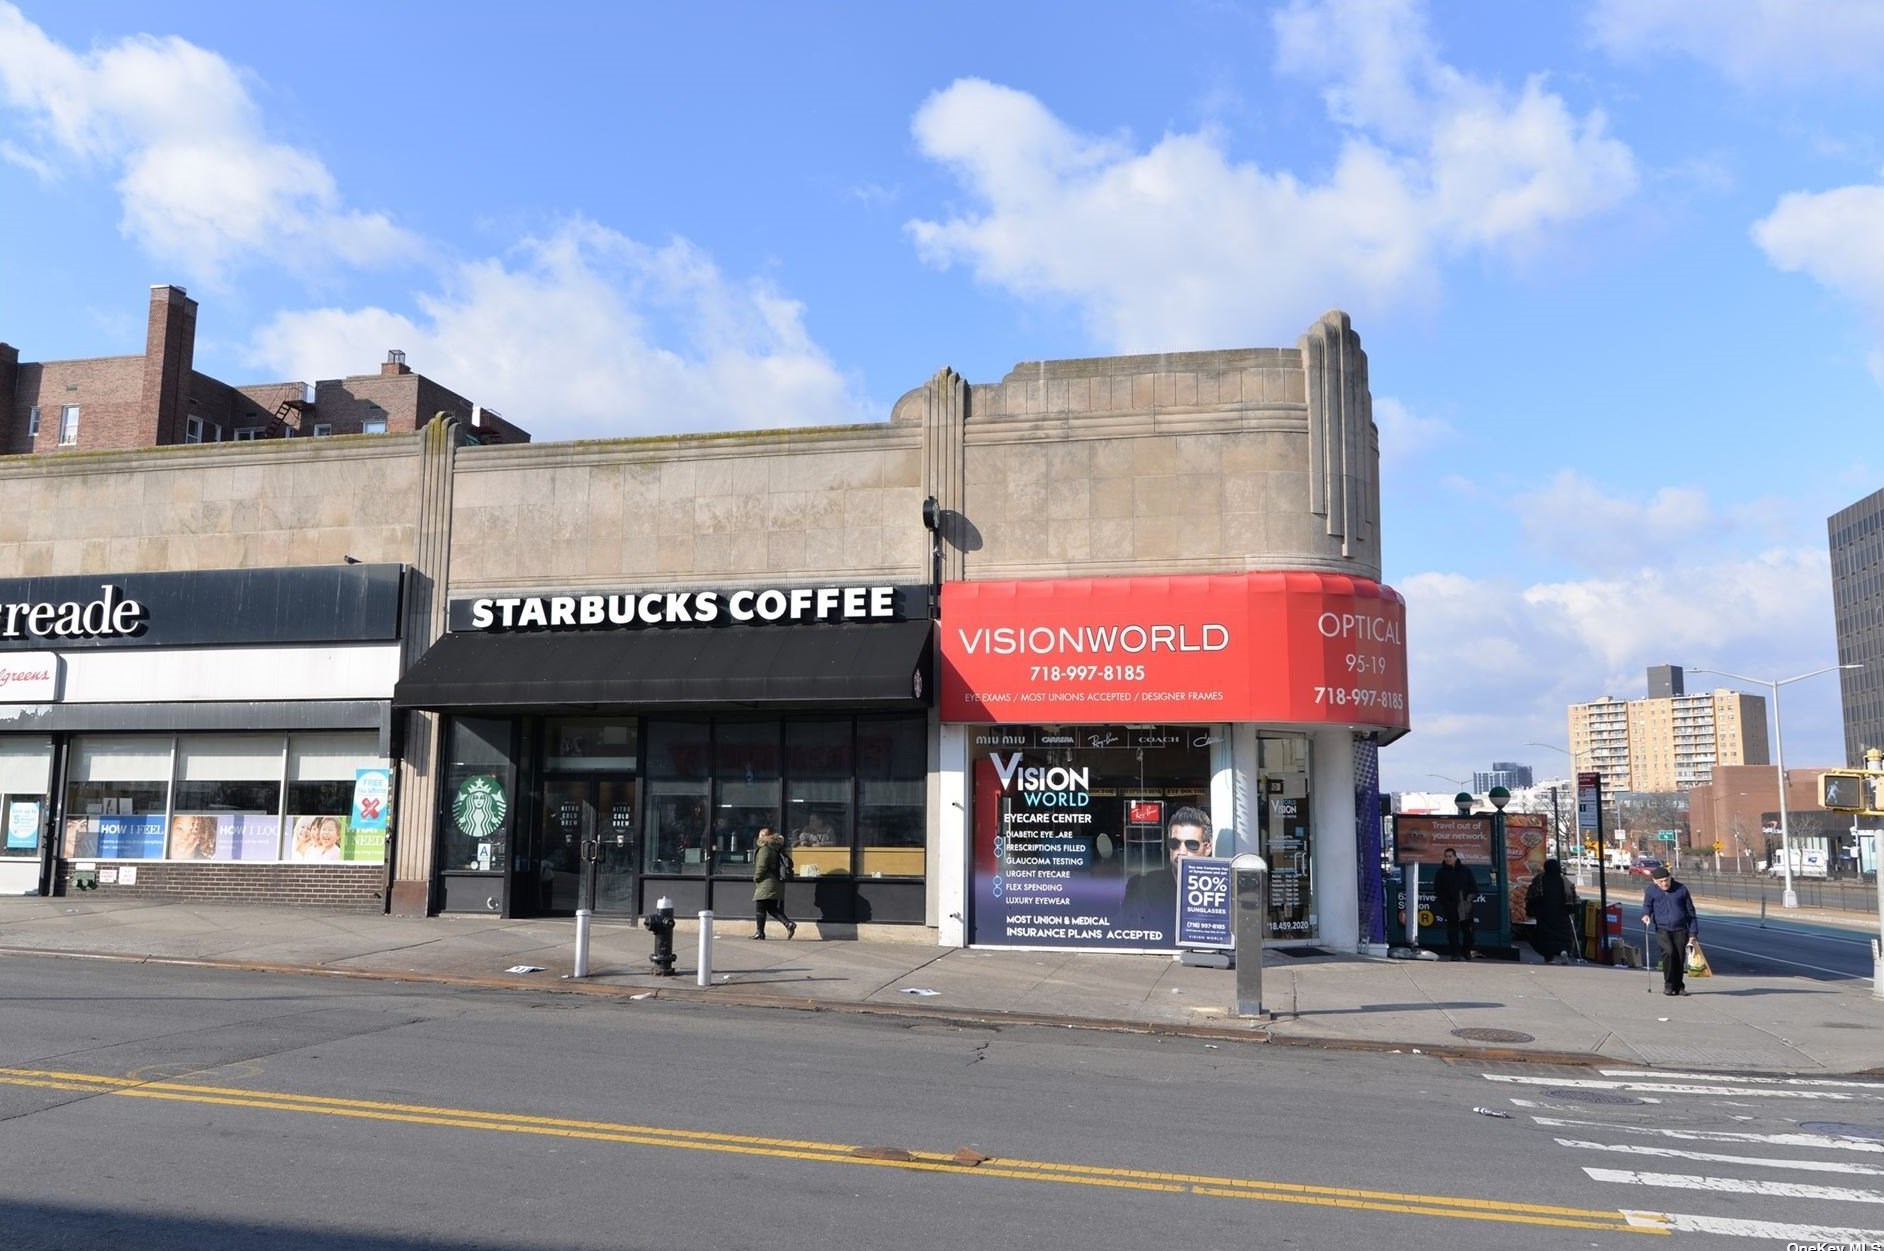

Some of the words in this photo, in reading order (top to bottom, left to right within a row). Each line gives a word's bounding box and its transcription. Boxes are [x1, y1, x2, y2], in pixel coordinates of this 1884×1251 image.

[0, 584, 140, 636] reade
[472, 591, 718, 628] STARBUCKS
[729, 586, 894, 621] COFFEE
[1318, 612, 1401, 645] OPTICAL
[1345, 653, 1386, 675] 95-19
[1030, 665, 1146, 682] 718-997-8185
[965, 693, 979, 702] EYE
[982, 693, 1011, 702] EXAMS
[1020, 692, 1046, 702] MOST
[1048, 692, 1085, 702] UNIONS
[1087, 692, 1132, 702] ACCEPTED
[1141, 692, 1186, 701] DESIGNER
[1188, 691, 1224, 701] FRAMES
[1313, 686, 1403, 710] 718-997-8185
[1024, 792, 1089, 807] WORLD
[1004, 813, 1049, 823] EYECARE
[1051, 813, 1092, 824] CENTER
[101, 824, 127, 834] HOW
[130, 825, 134, 834] I
[136, 824, 164, 835] FEEL
[220, 825, 247, 835] HOW
[256, 825, 289, 836] LOO
[1432, 821, 1455, 830] Travel
[1456, 822, 1471, 830] out
[1472, 821, 1482, 830] of
[1006, 831, 1038, 839] DIABETIC
[1040, 831, 1054, 839] EYE
[1055, 831, 1073, 839] ARE
[1432, 832, 1450, 840] your
[1452, 832, 1487, 840] network.
[479, 845, 489, 857] A
[1006, 844, 1062, 852] PRESCRIPTIONS
[1063, 844, 1086, 852] FILLED
[1006, 857, 1050, 865] GLAUCOMA
[1053, 857, 1084, 866] TESTING
[1006, 870, 1036, 878] URGENT
[1038, 870, 1071, 878] EYECARE
[1024, 884, 1063, 892] SPENDING
[1006, 897, 1033, 905] LUXURY
[1035, 897, 1070, 905] EYEWEAR
[1188, 891, 1226, 907] OFF
[1006, 915, 1032, 924] MOST
[1033, 916, 1062, 925] UNION
[1072, 917, 1110, 925] MEDICAL
[1421, 913, 1429, 922] R
[1006, 928, 1066, 938] INSURANCE
[1068, 929, 1102, 939] PLANS
[1106, 930, 1163, 941] ACCEPTED
